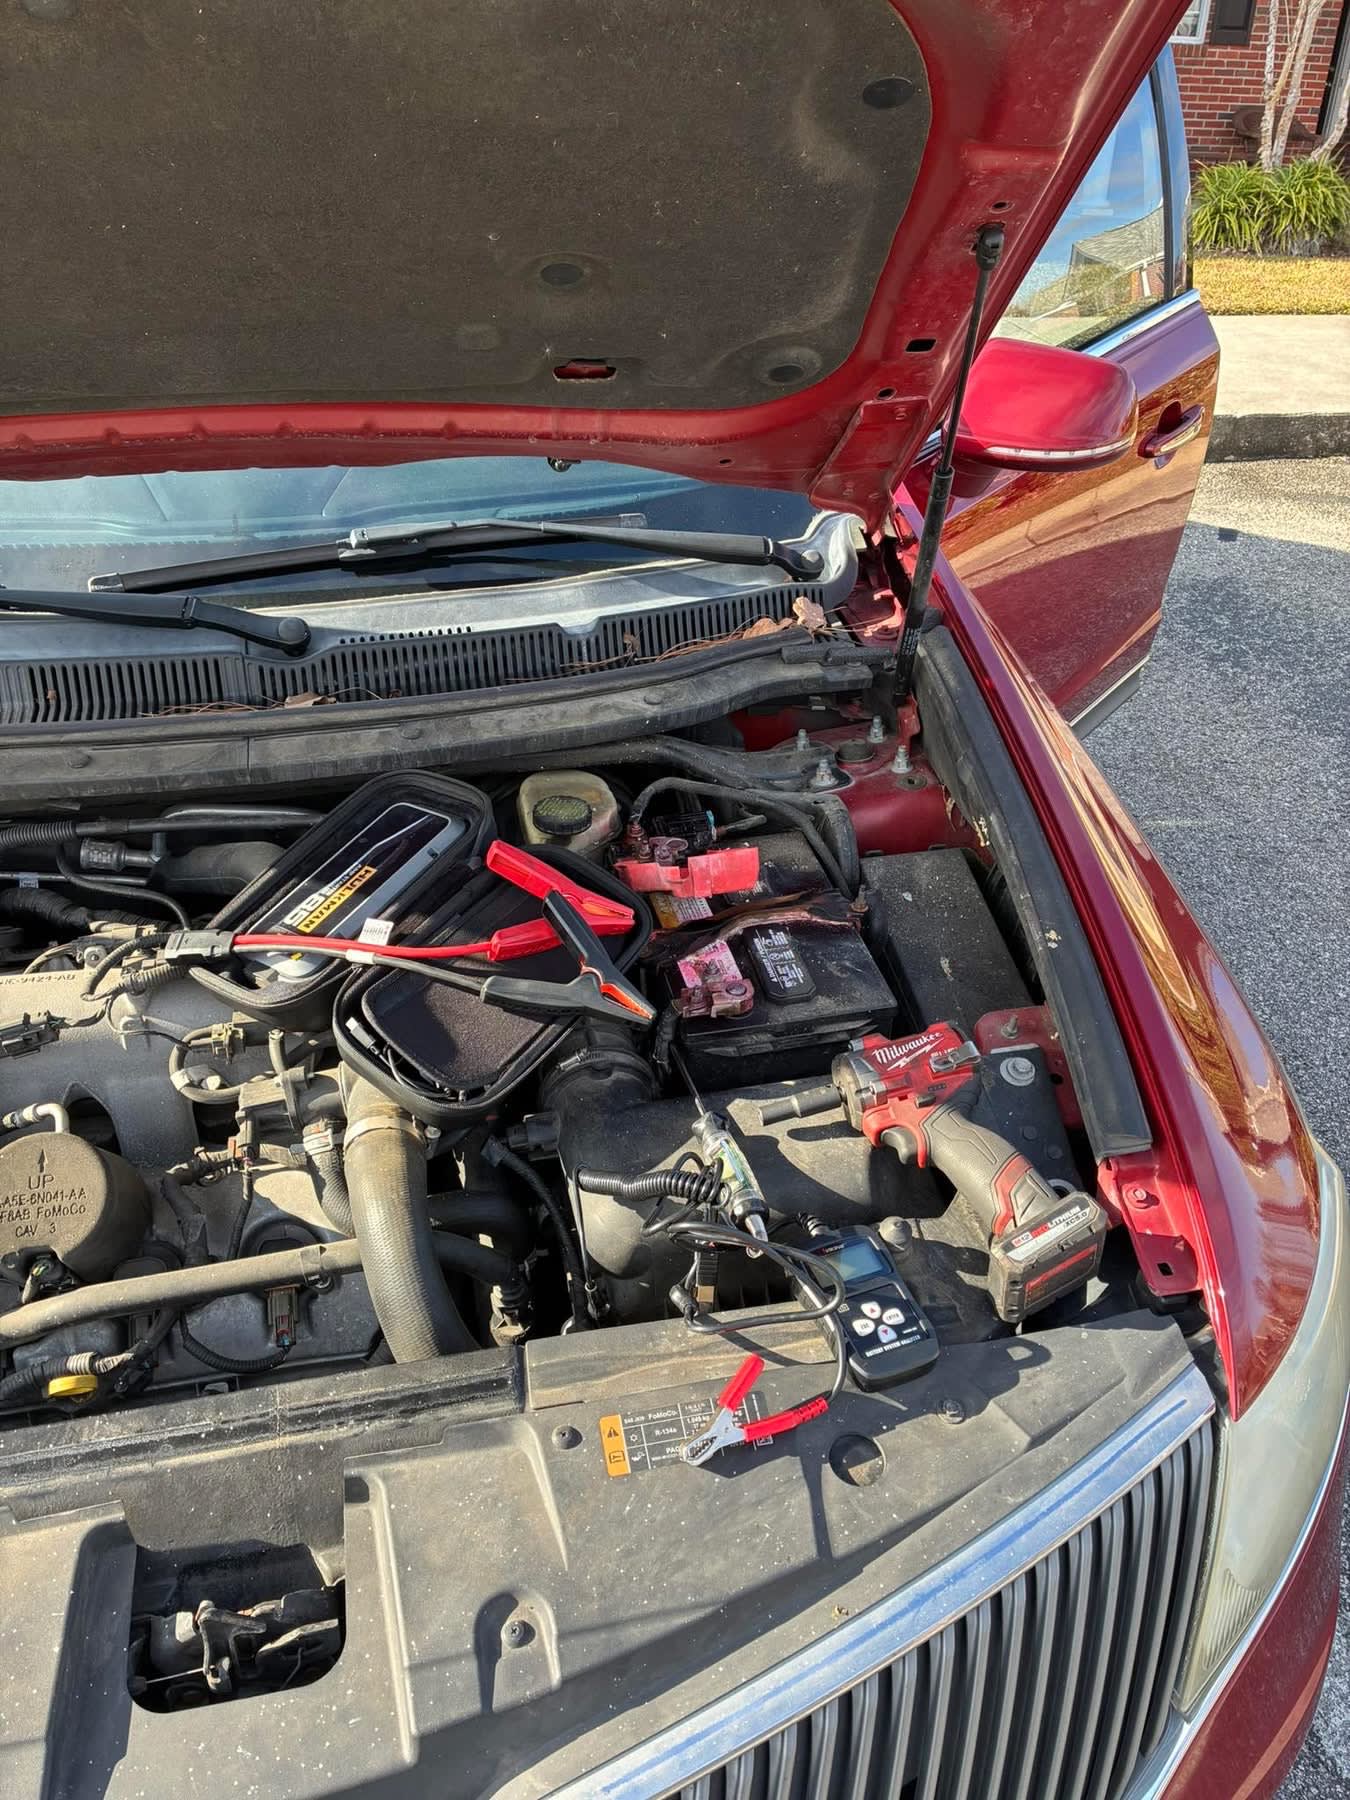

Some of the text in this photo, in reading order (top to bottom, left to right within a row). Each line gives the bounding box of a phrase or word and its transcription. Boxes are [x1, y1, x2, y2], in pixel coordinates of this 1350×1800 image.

[304, 867, 373, 930] HULKMAN
[872, 1030, 945, 1066] Milwaukee
[28, 1174, 54, 1190] UP
[36, 1203, 87, 1219] FoMoCo
[15, 1223, 38, 1239] CAV
